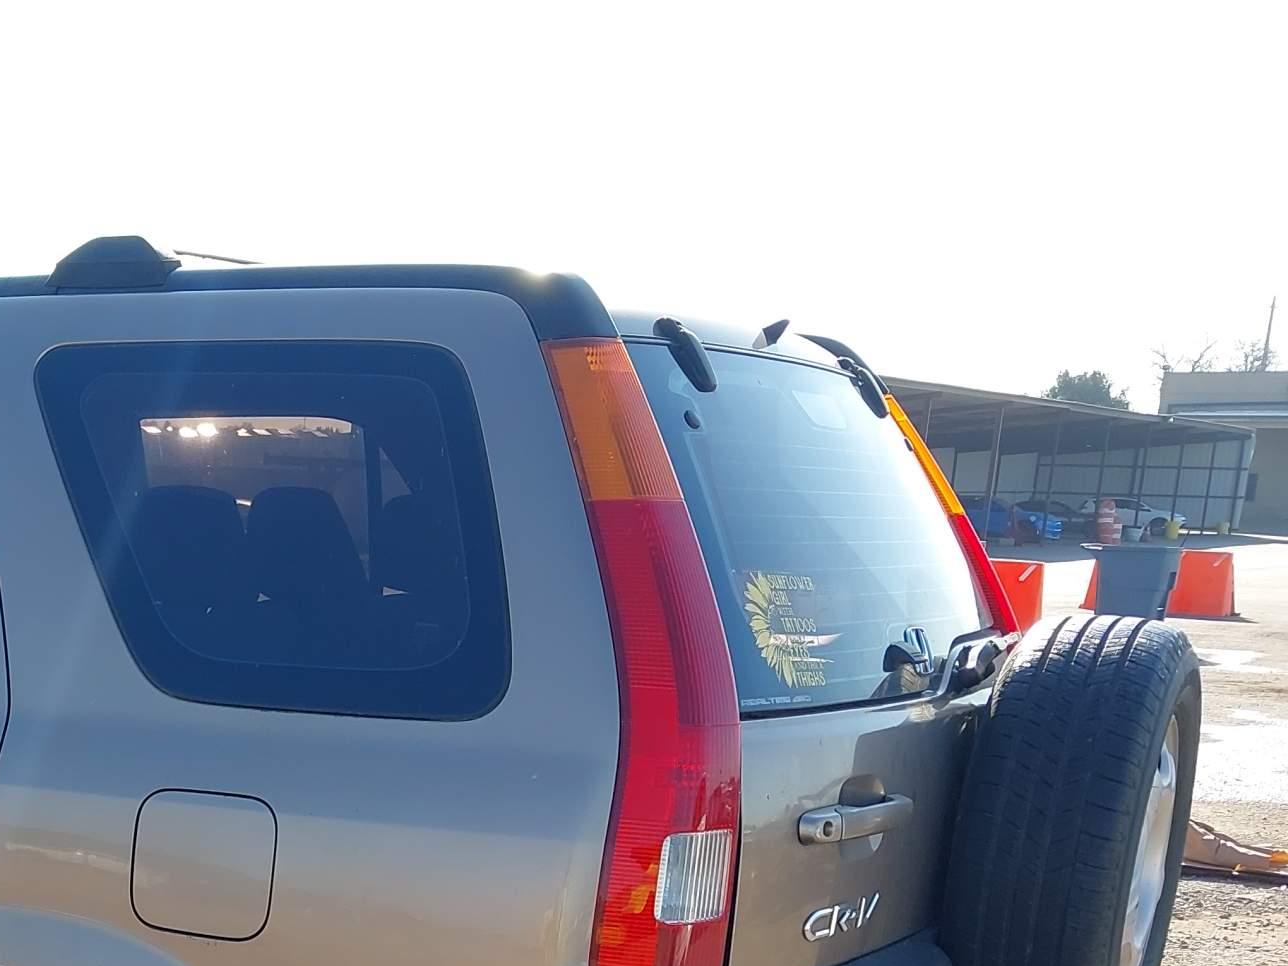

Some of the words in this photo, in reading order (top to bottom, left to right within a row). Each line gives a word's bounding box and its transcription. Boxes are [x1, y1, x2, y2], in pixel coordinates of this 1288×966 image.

[767, 574, 815, 591] SUNFLOWER
[773, 590, 792, 606] GIRL
[780, 617, 817, 633] TATTOOS
[796, 671, 826, 687] THIGHS
